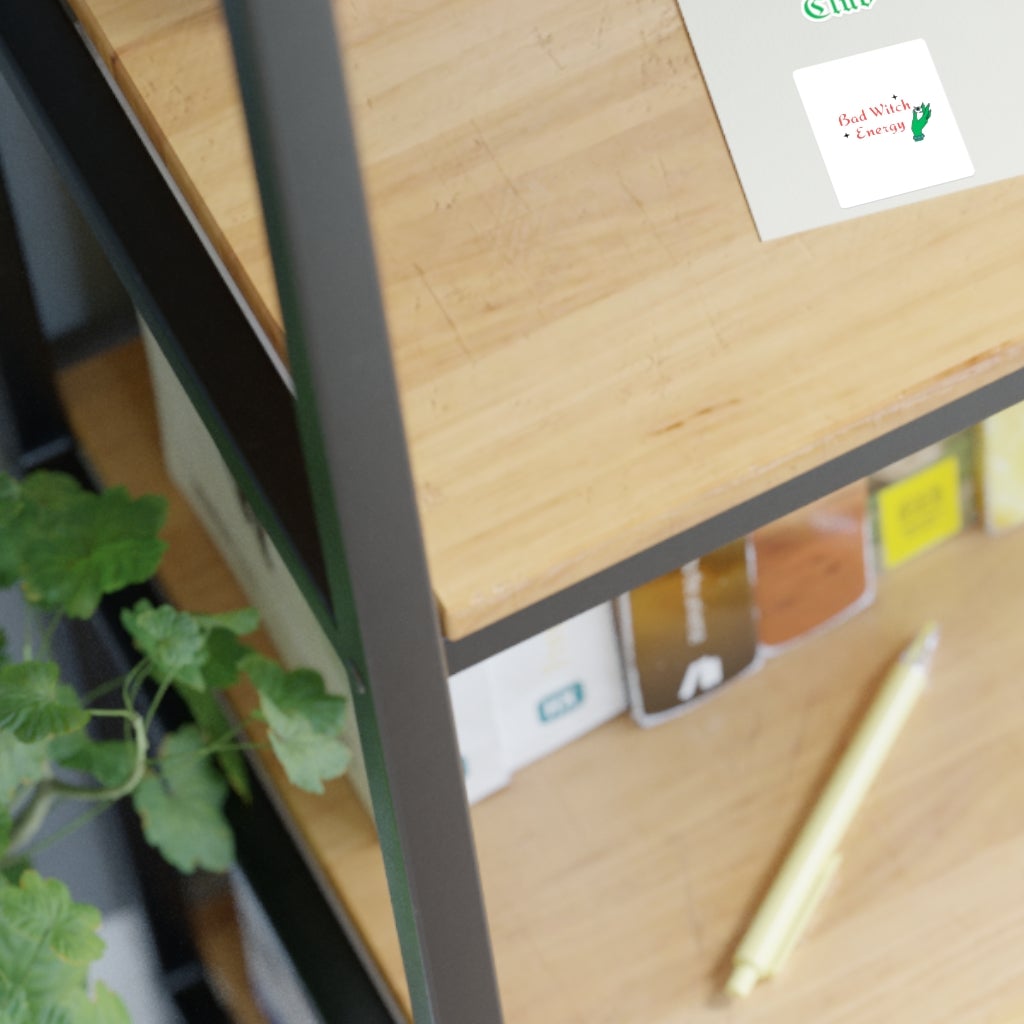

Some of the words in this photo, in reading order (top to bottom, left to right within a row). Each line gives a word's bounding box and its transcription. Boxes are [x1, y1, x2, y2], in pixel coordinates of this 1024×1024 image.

[838, 108, 868, 127] Bad
[869, 98, 911, 118] Witch
[856, 121, 906, 140] Energy
